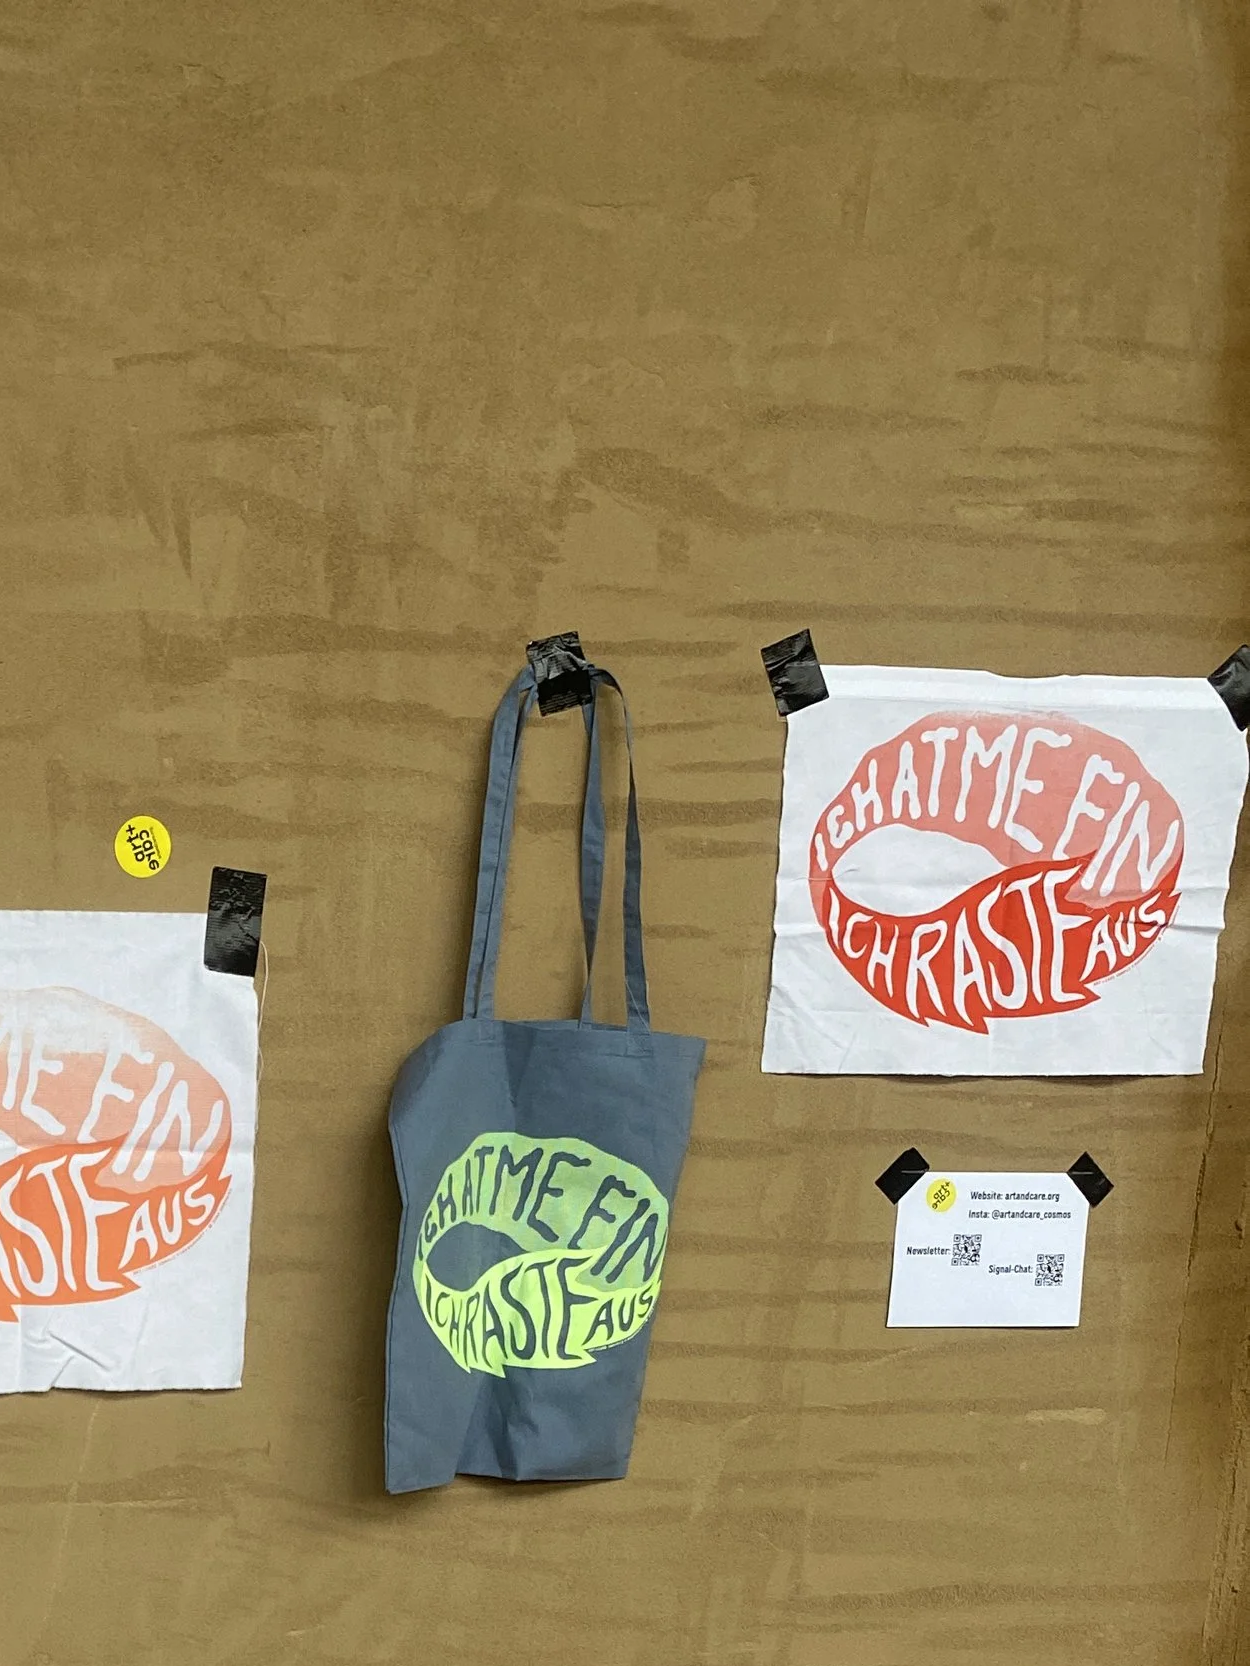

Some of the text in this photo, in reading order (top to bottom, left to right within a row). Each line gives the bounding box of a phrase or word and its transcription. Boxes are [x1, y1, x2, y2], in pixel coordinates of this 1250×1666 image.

[126, 825, 145, 862] art+
[1079, 893, 1166, 982] AUS
[970, 1191, 1060, 1203] Website: artandcare.org
[118, 1174, 215, 1271] AUS
[968, 1210, 1072, 1221] Insta: @artandcare_cosmos
[906, 1246, 951, 1256] Newsletter:
[988, 1265, 1033, 1275] Signal-Chat:
[582, 1285, 654, 1346] AUS
